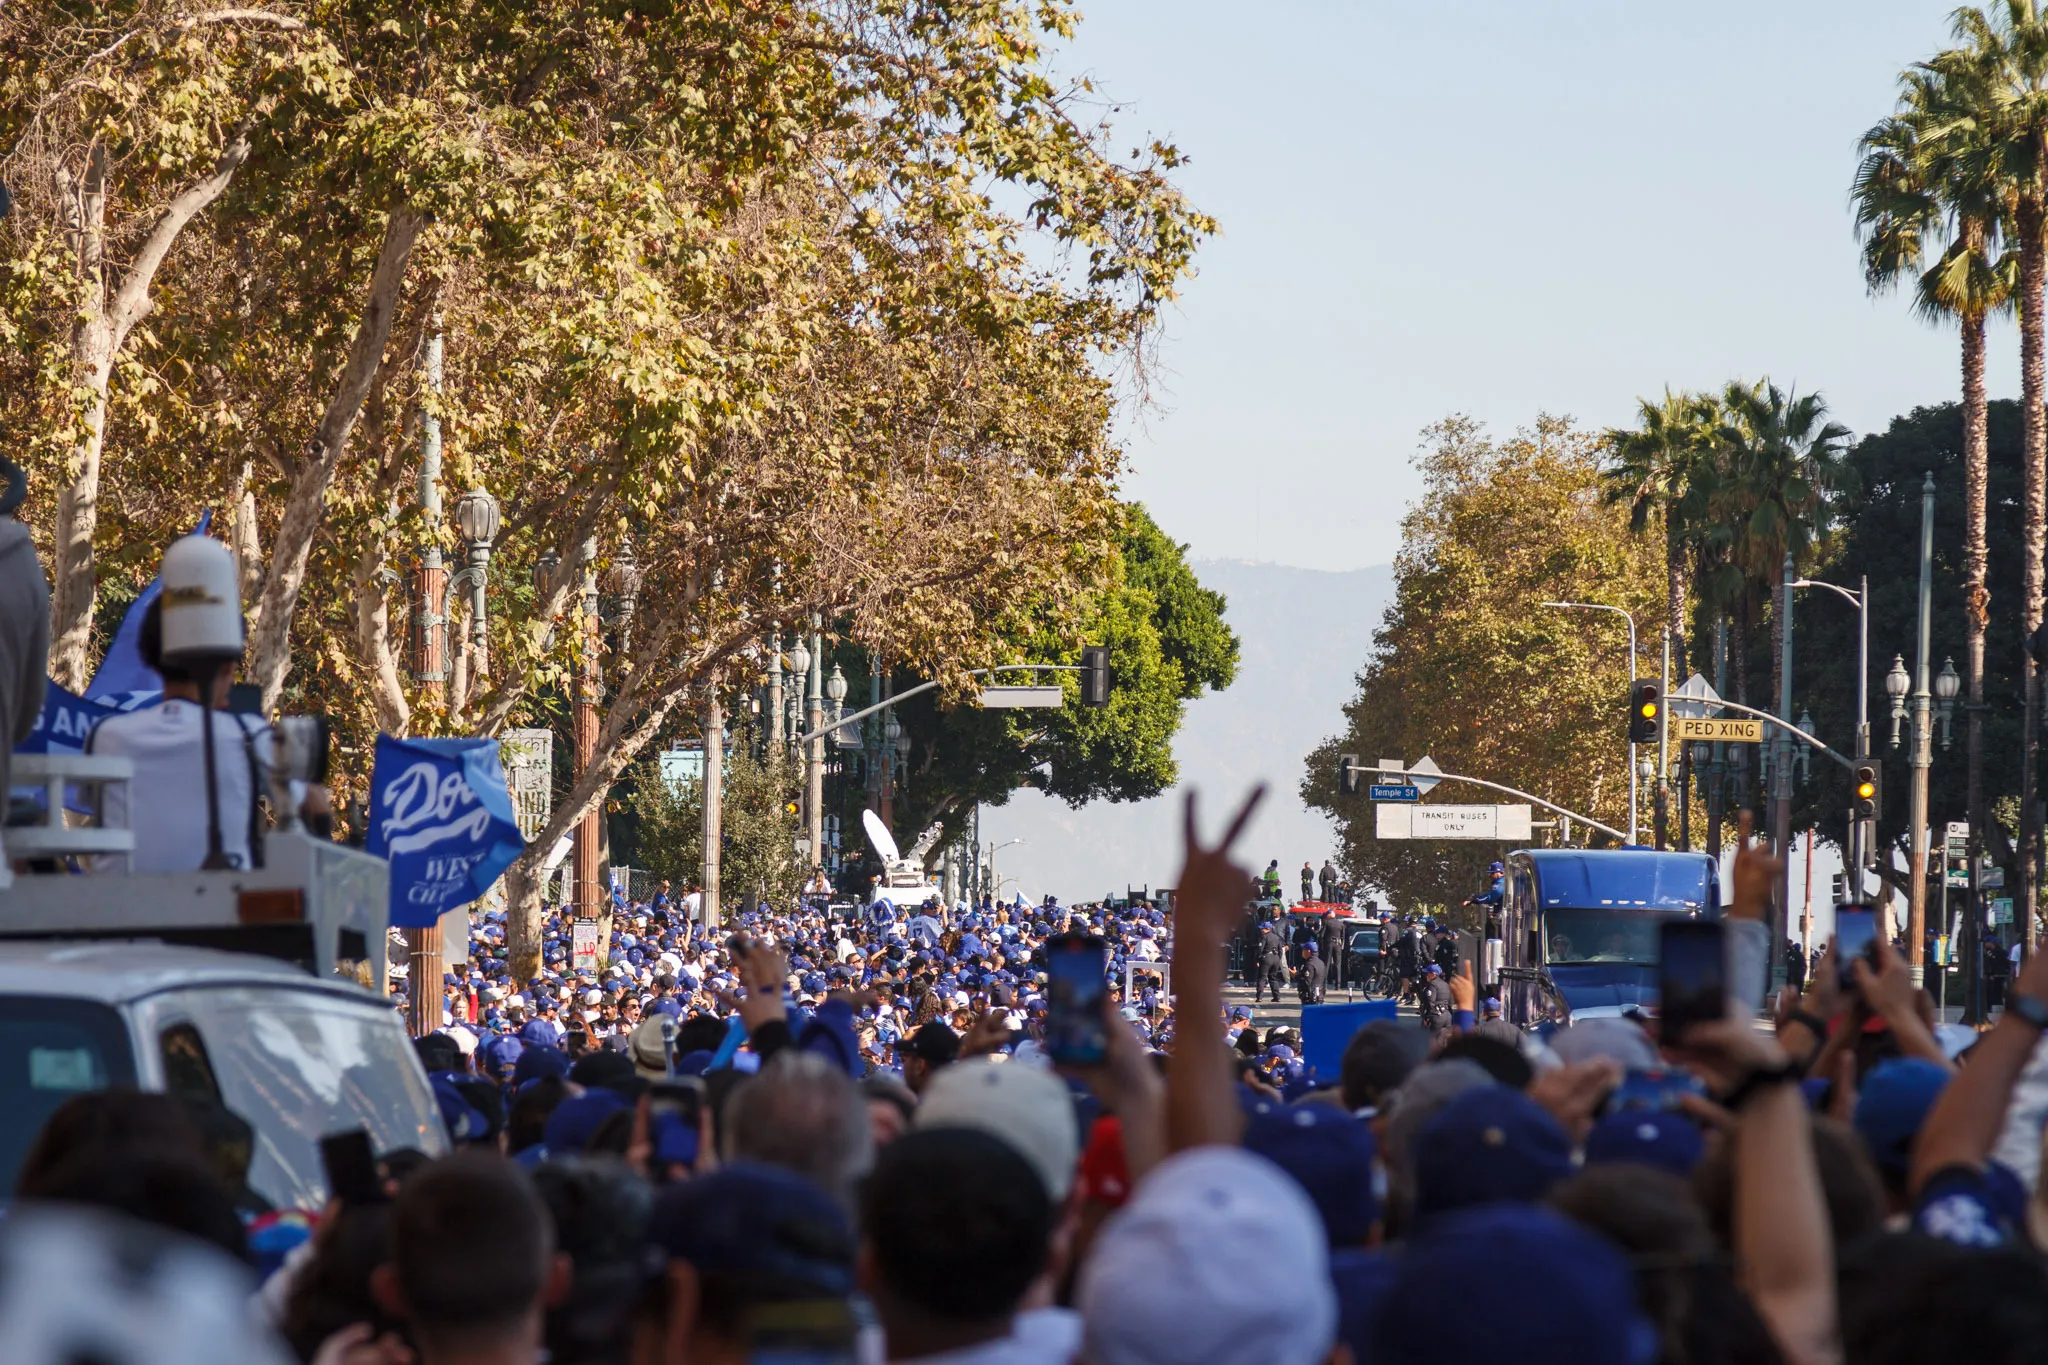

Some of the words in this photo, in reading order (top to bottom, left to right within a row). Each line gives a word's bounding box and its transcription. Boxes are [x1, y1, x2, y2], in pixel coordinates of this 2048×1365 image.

[1685, 722, 1714, 735] PED
[1720, 723, 1755, 737] XING
[1374, 788, 1401, 797] Temple
[1405, 789, 1415, 797] St
[1421, 812, 1454, 820] TRANSIT
[1460, 812, 1487, 820] BUSES
